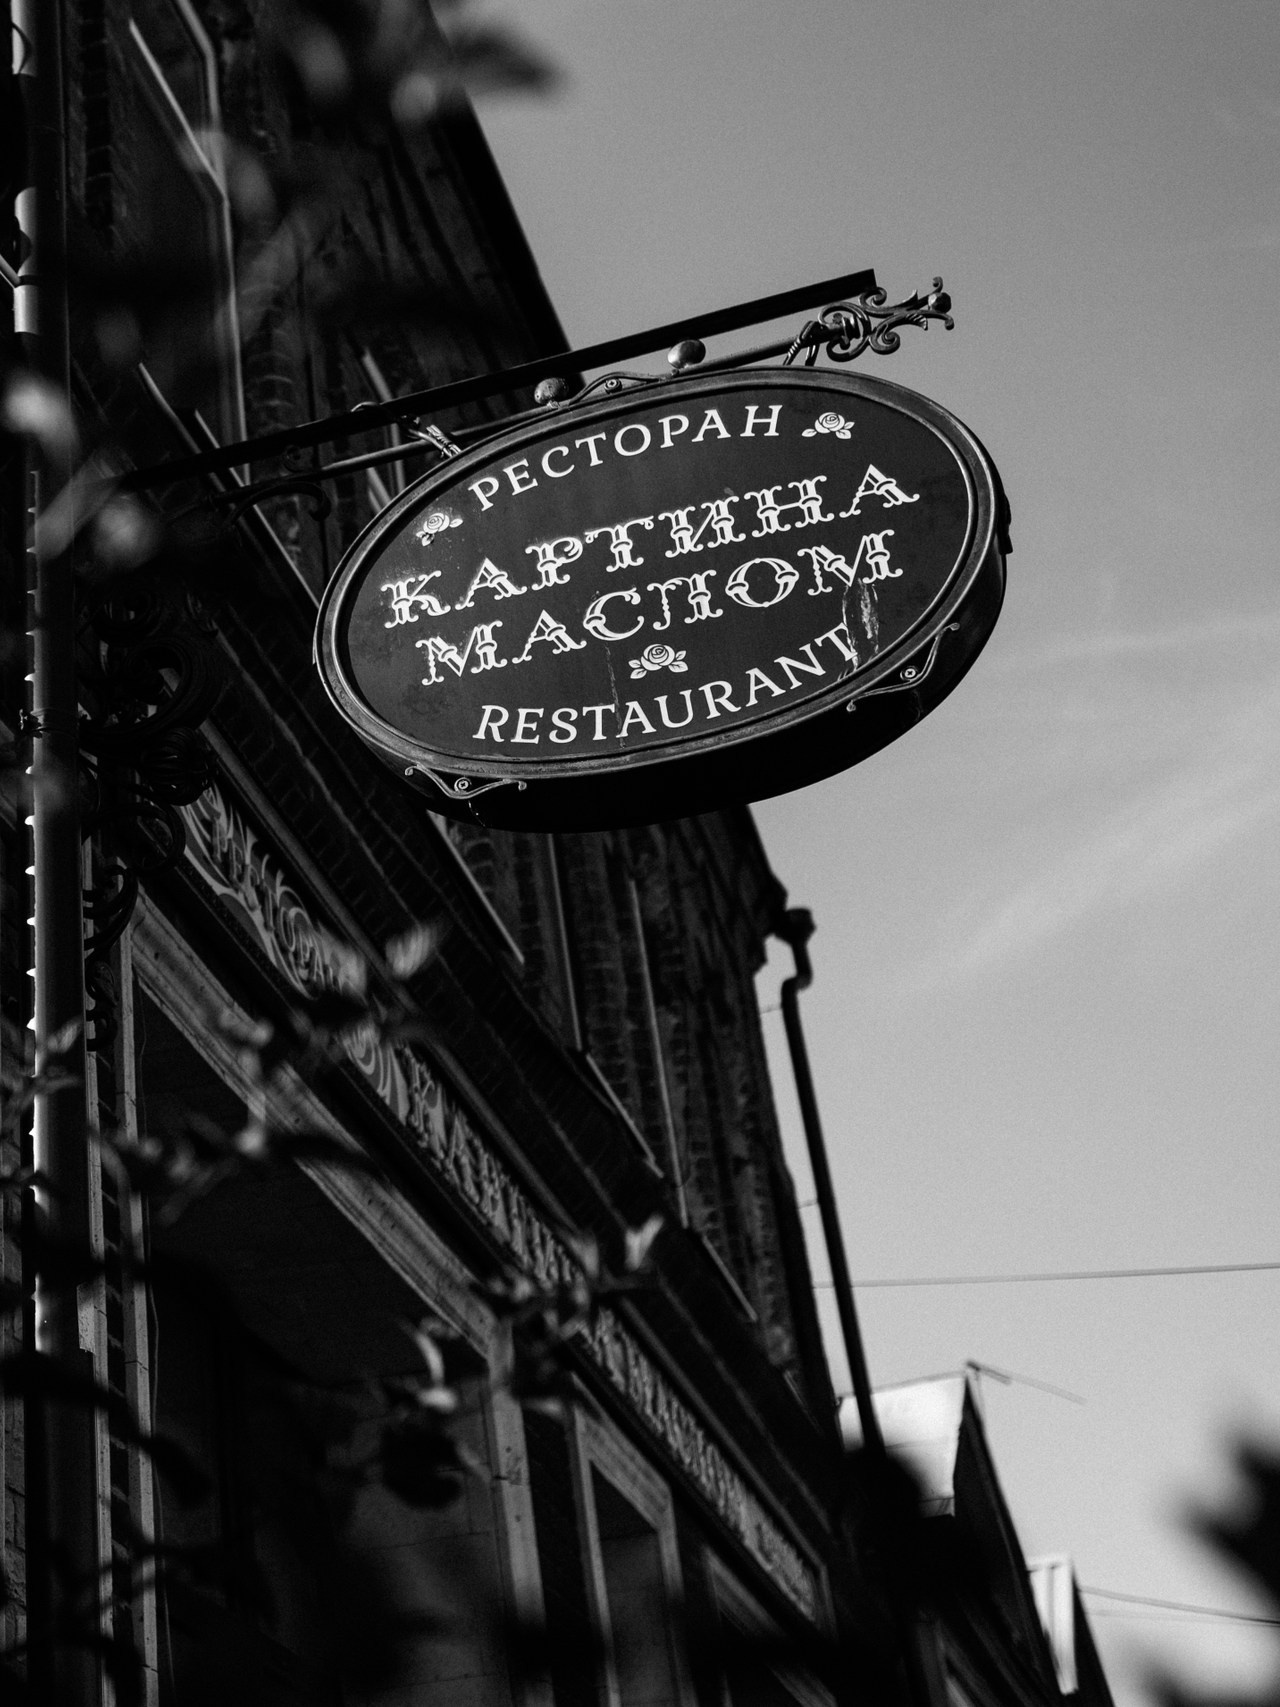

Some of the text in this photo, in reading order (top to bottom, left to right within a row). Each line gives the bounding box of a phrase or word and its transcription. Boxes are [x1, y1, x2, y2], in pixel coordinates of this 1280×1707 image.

[468, 404, 783, 512] РЕСТОРАН
[380, 463, 921, 629] КАРТИНА
[415, 528, 904, 686] МАСЛОМ
[472, 622, 858, 745] RESTAURANT
